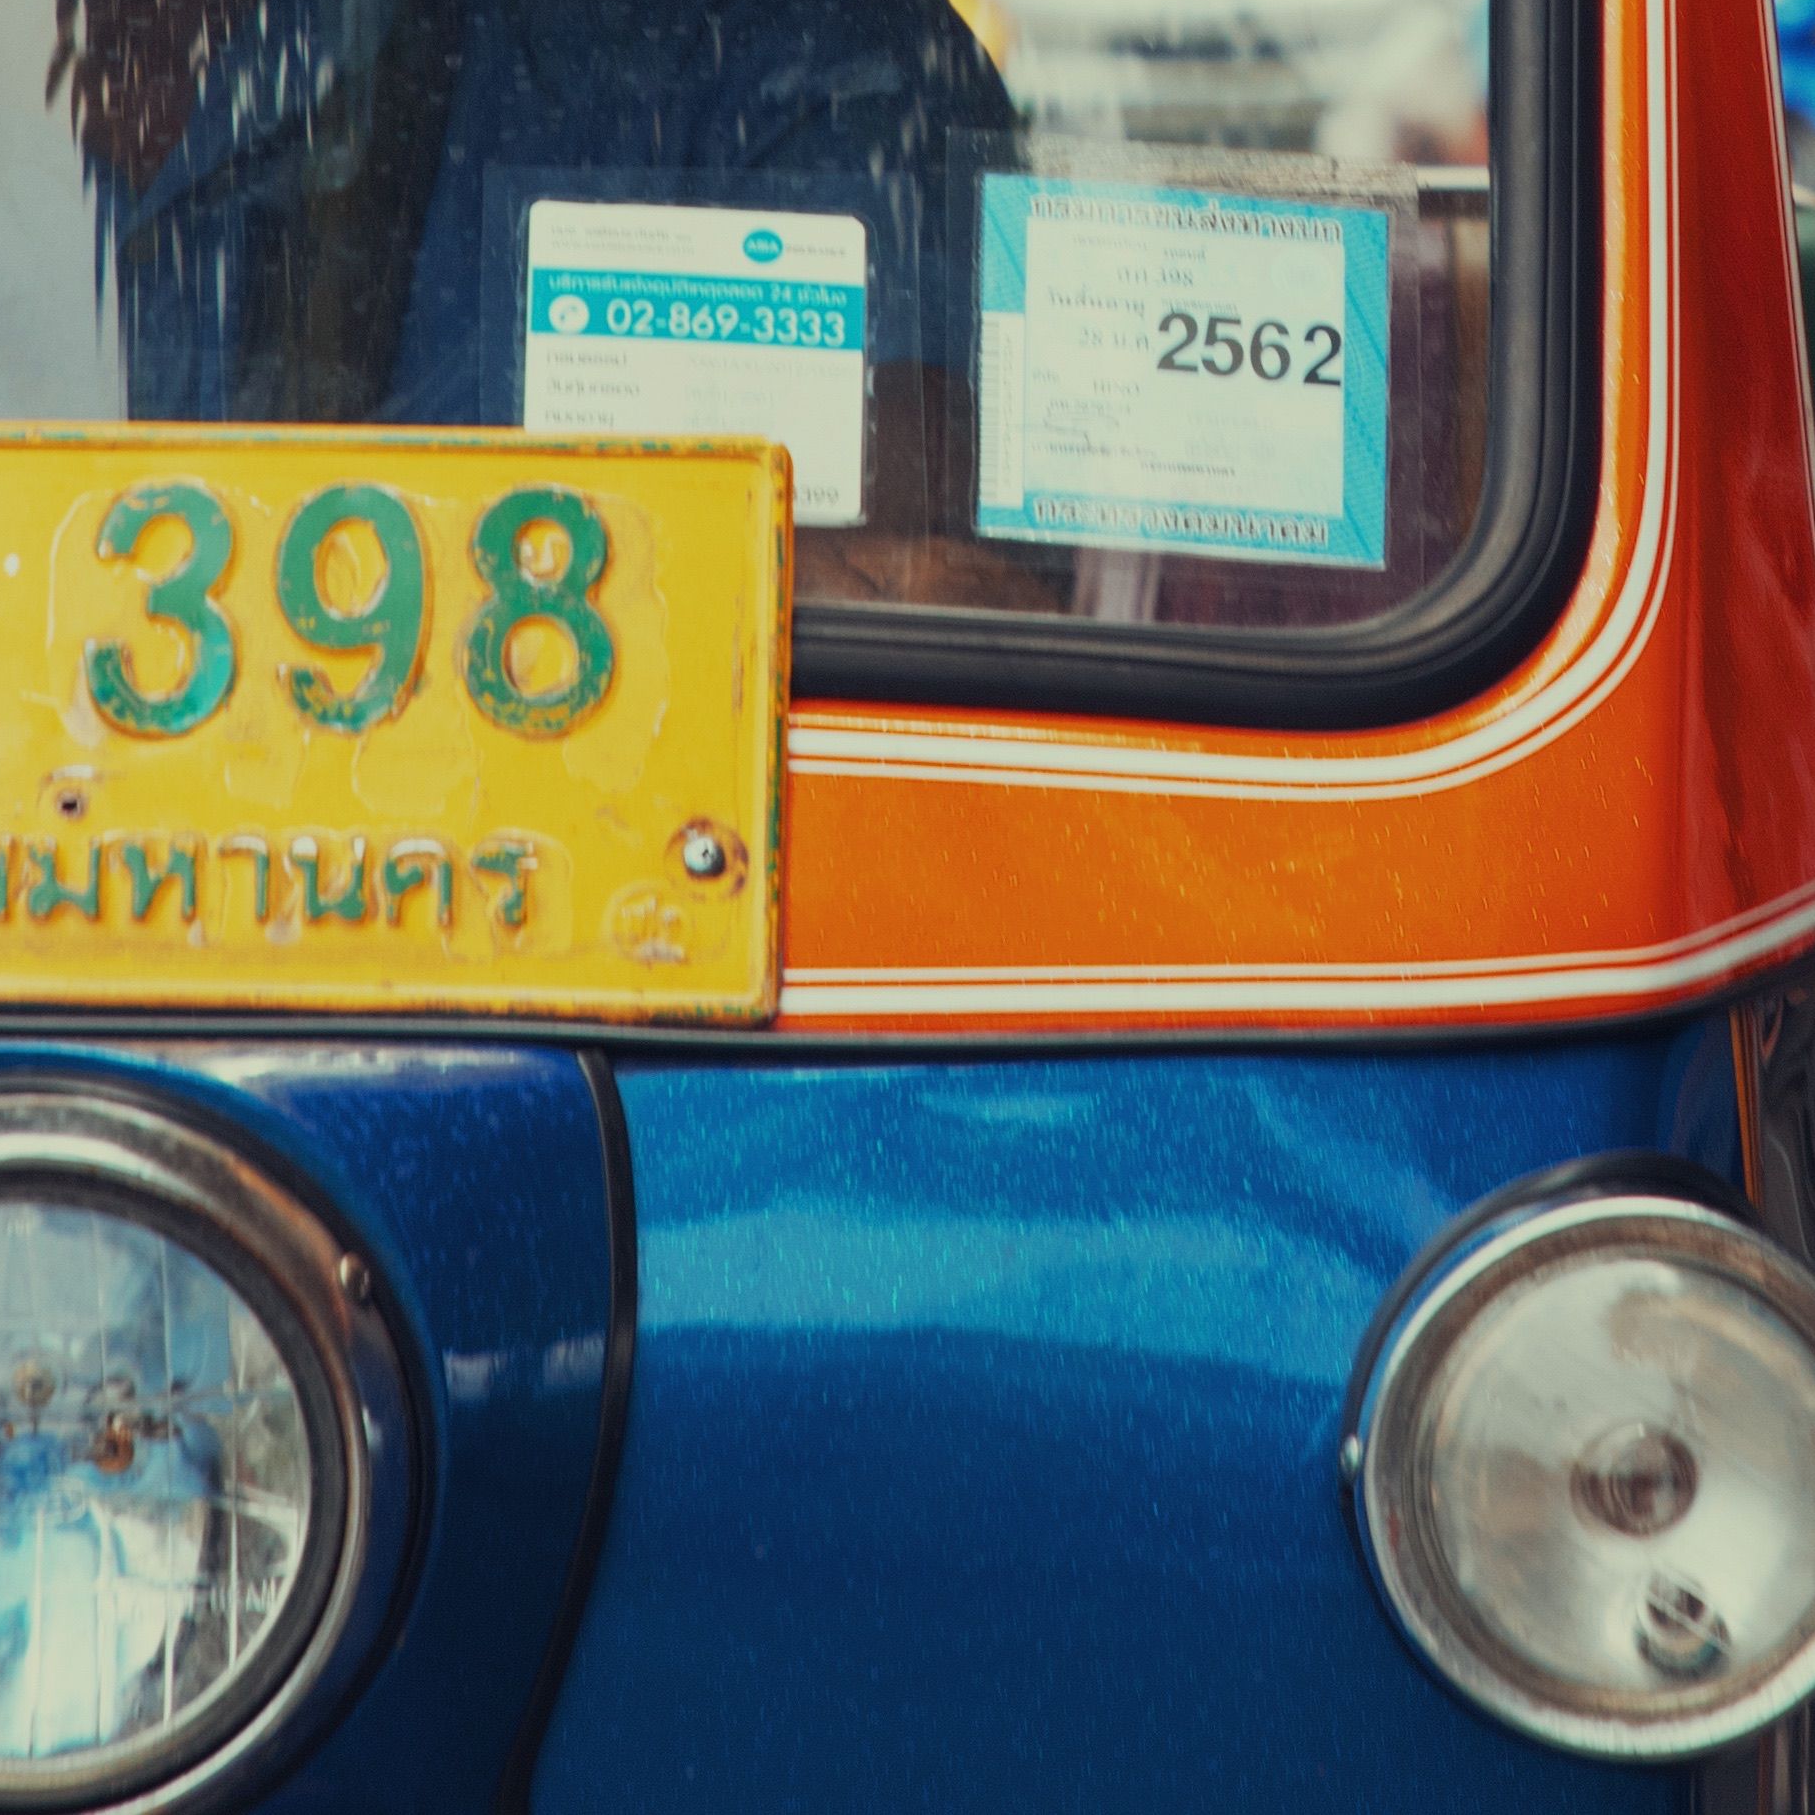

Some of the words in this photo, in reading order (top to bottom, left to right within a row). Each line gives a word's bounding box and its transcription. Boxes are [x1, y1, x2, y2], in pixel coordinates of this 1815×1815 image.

[606, 297, 846, 348] 02-869-3333
[1156, 312, 1343, 387] 2562
[82, 480, 616, 742] 398
